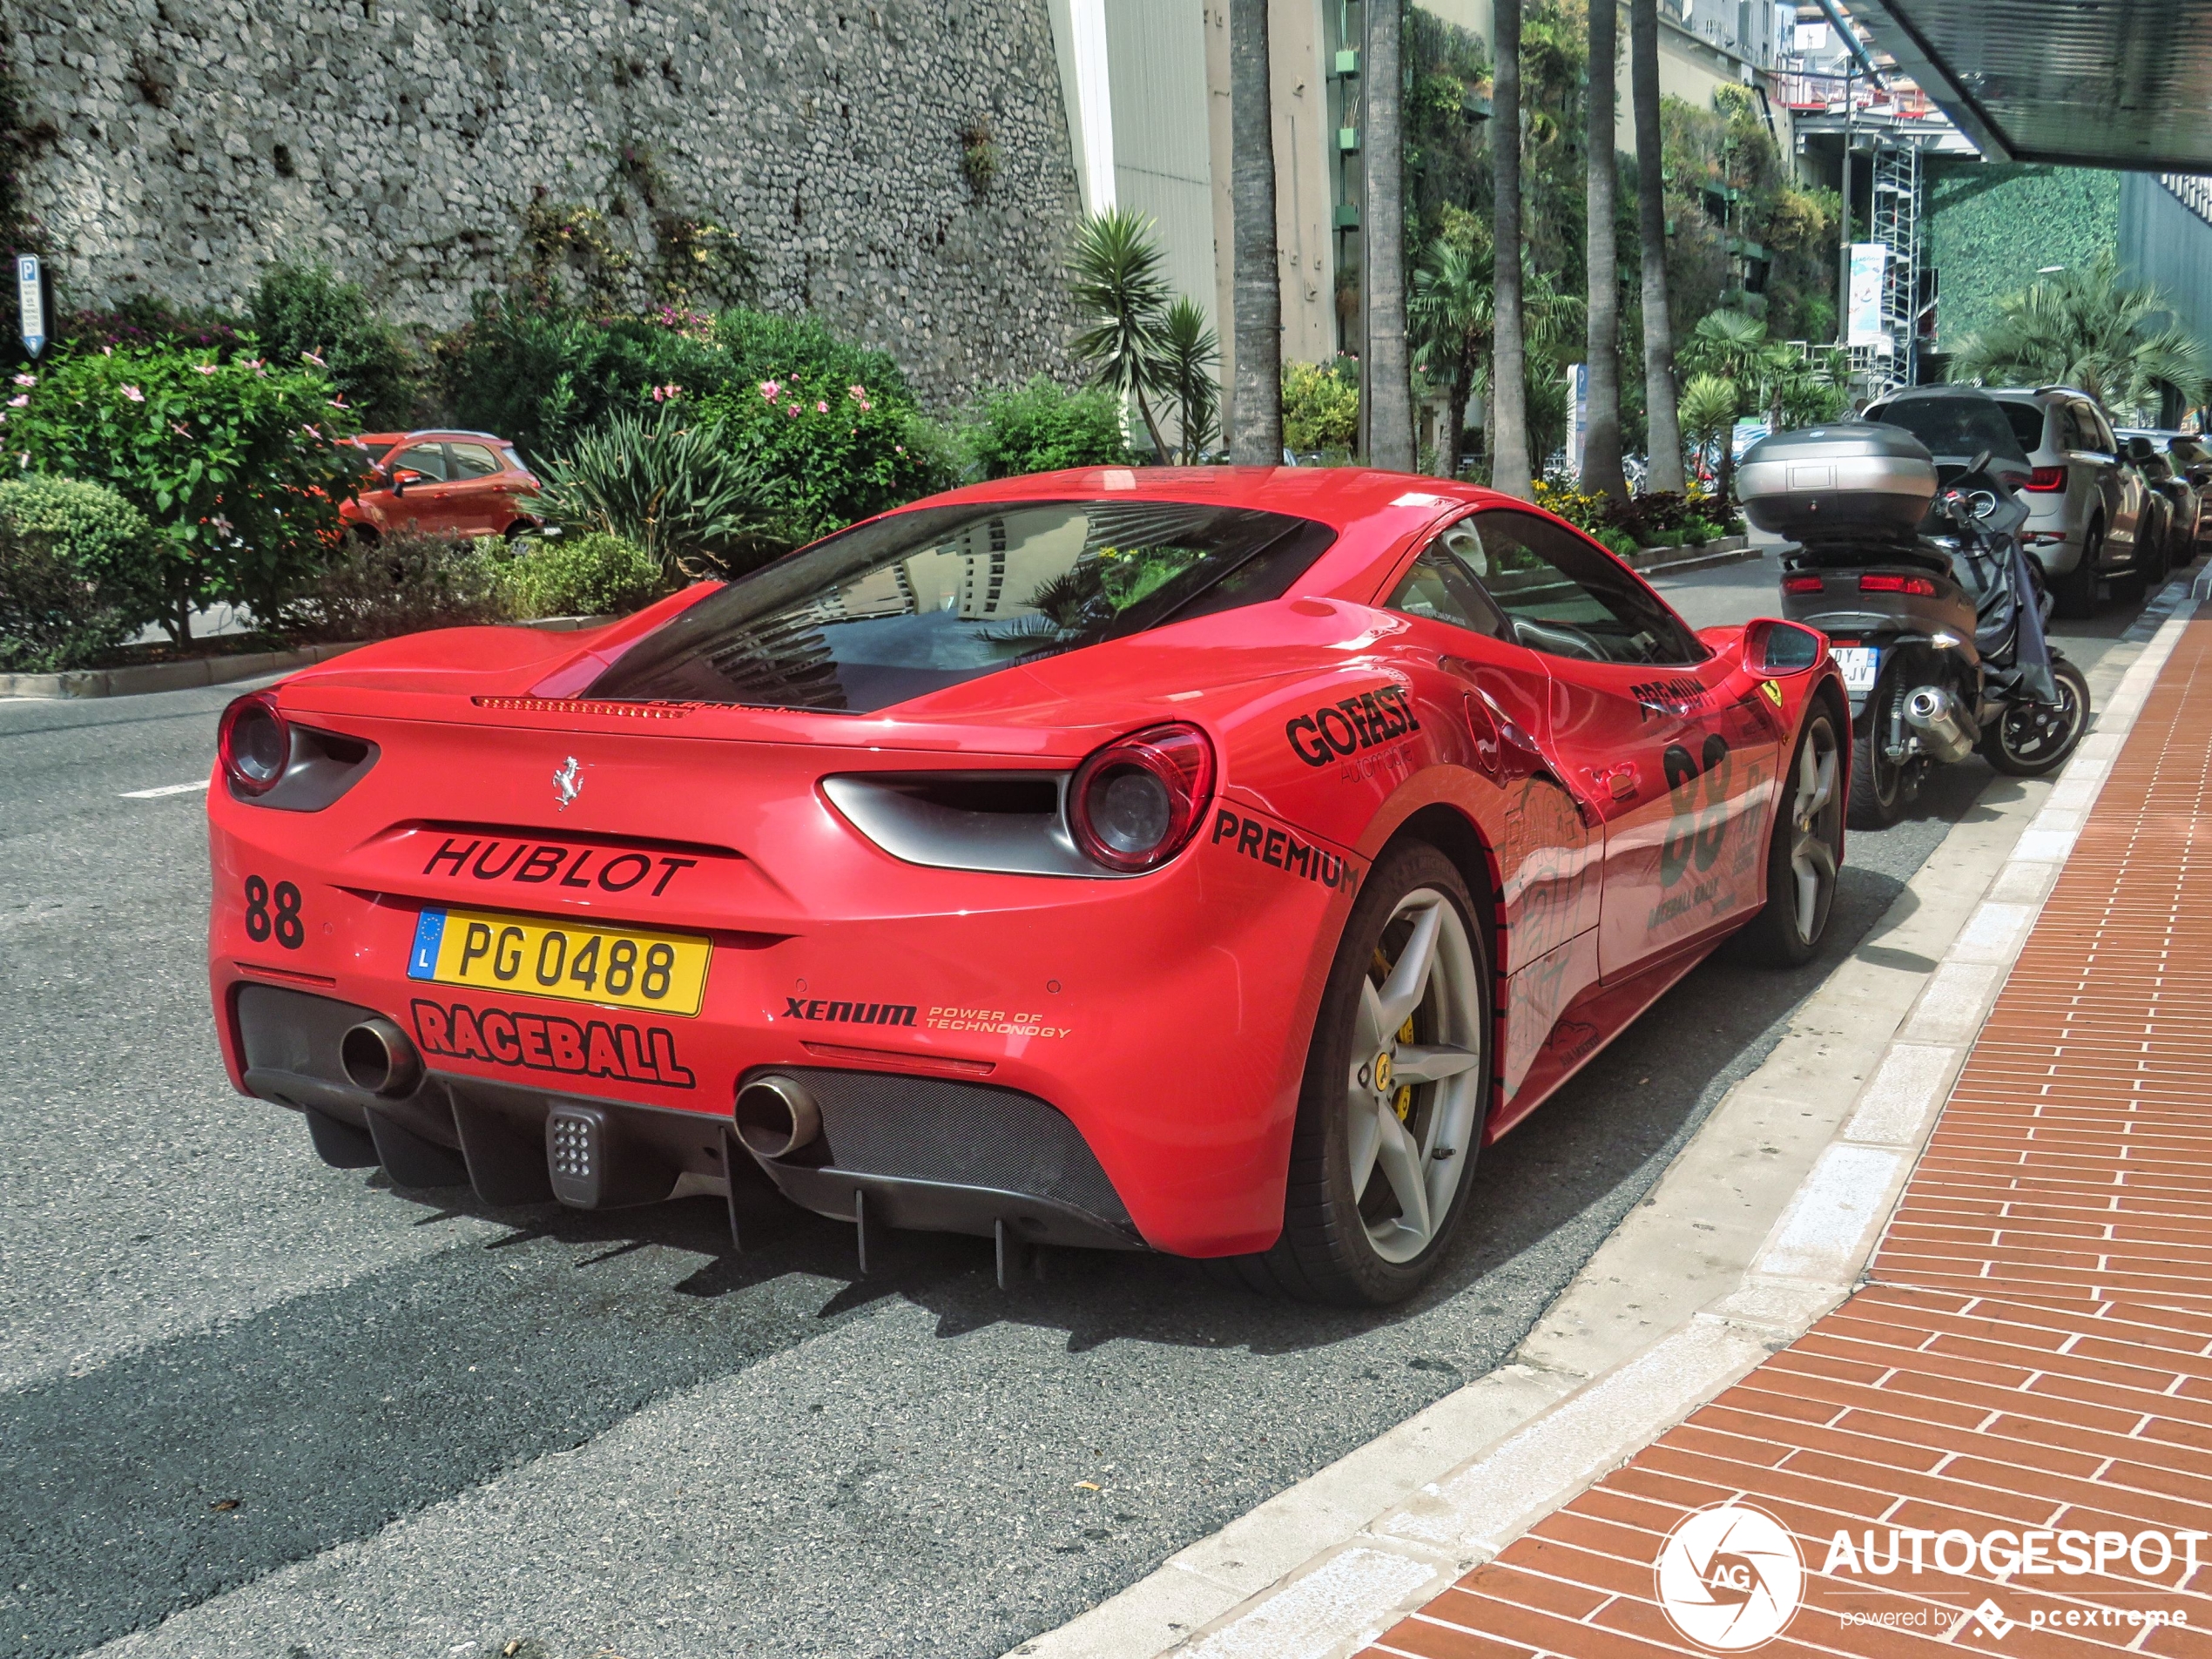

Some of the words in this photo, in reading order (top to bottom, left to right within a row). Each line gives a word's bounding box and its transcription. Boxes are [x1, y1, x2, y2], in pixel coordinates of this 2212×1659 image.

[24, 262, 33, 279] P
[1579, 370, 1585, 388] P
[1285, 684, 1420, 767] GOFAST
[1660, 733, 1732, 888] 88
[422, 838, 699, 897] HUBLOT
[1211, 808, 1361, 899] PREMIUM
[244, 874, 305, 950] 88
[419, 948, 429, 968] L
[460, 922, 524, 981] PG
[536, 931, 675, 1000] 0488
[410, 998, 697, 1089] RACEBALL
[928, 1007, 1005, 1022] POWER
[1014, 1012, 1043, 1023] OF
